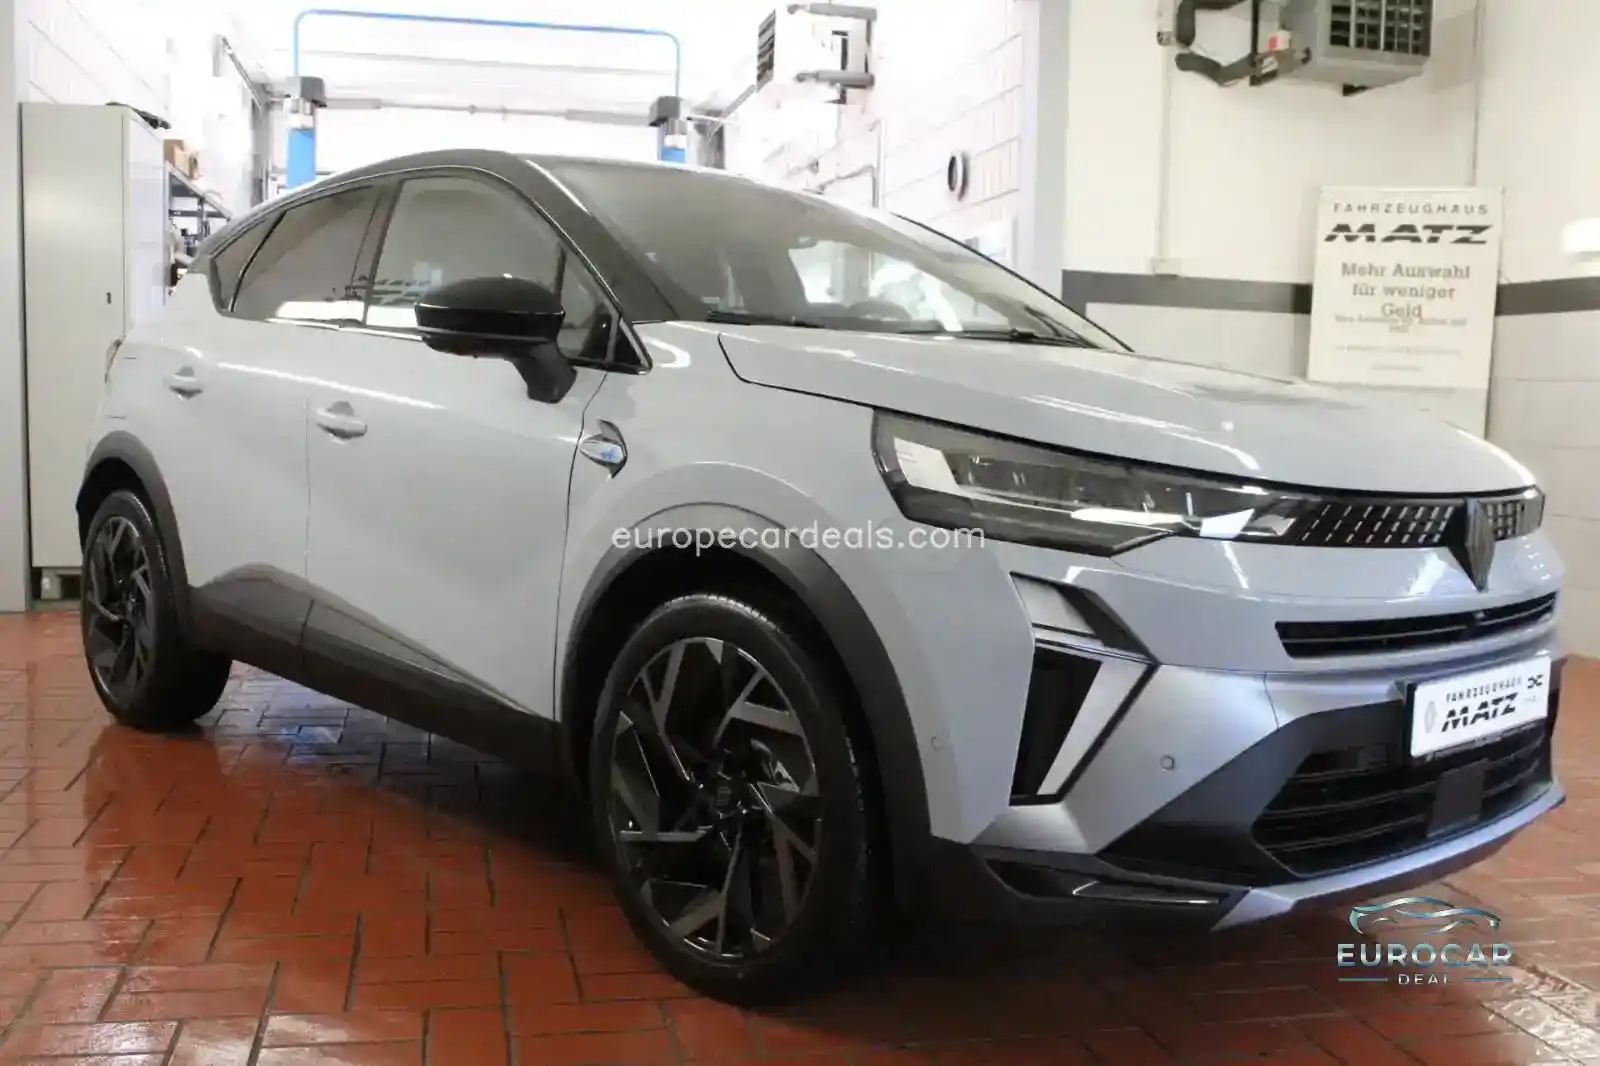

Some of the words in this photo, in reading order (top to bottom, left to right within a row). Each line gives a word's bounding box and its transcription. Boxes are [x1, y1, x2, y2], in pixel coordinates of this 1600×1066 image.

[1333, 202, 1489, 216] FAHRZEUGHAUS
[1324, 223, 1493, 245] MATZ
[1341, 262, 1386, 278] Mehr
[1392, 263, 1471, 280] Auswahl
[1352, 283, 1376, 297] für
[1383, 286, 1456, 301] weniger
[1380, 302, 1423, 319] Geld
[1441, 692, 1519, 732] MATZ
